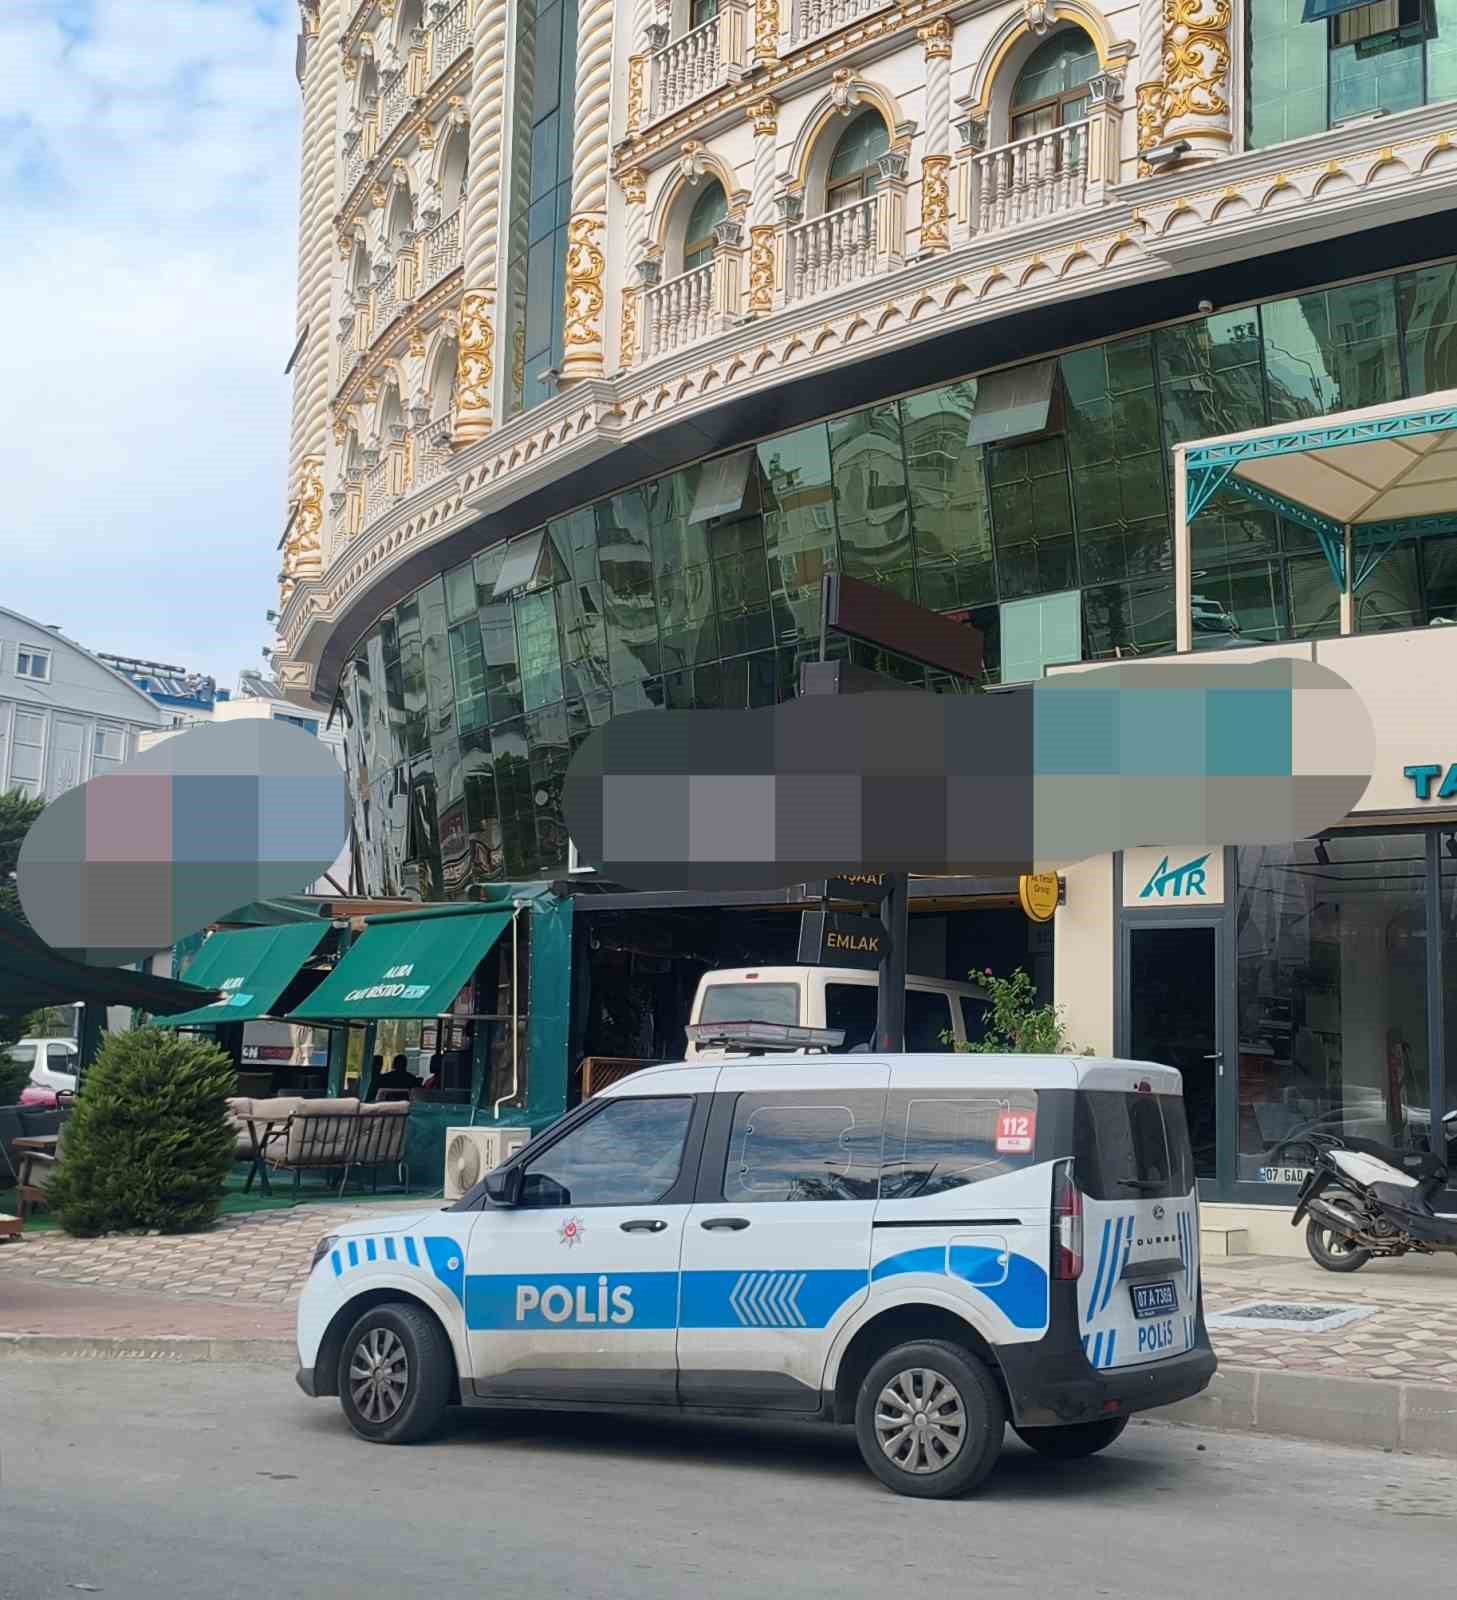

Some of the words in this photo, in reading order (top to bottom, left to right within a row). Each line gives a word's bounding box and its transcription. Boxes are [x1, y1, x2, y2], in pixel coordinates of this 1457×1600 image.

[827, 932, 880, 952] EMLAK
[1002, 1117, 1028, 1136] 112
[1266, 1168, 1278, 1181] 07
[516, 1275, 634, 1324] POLİS
